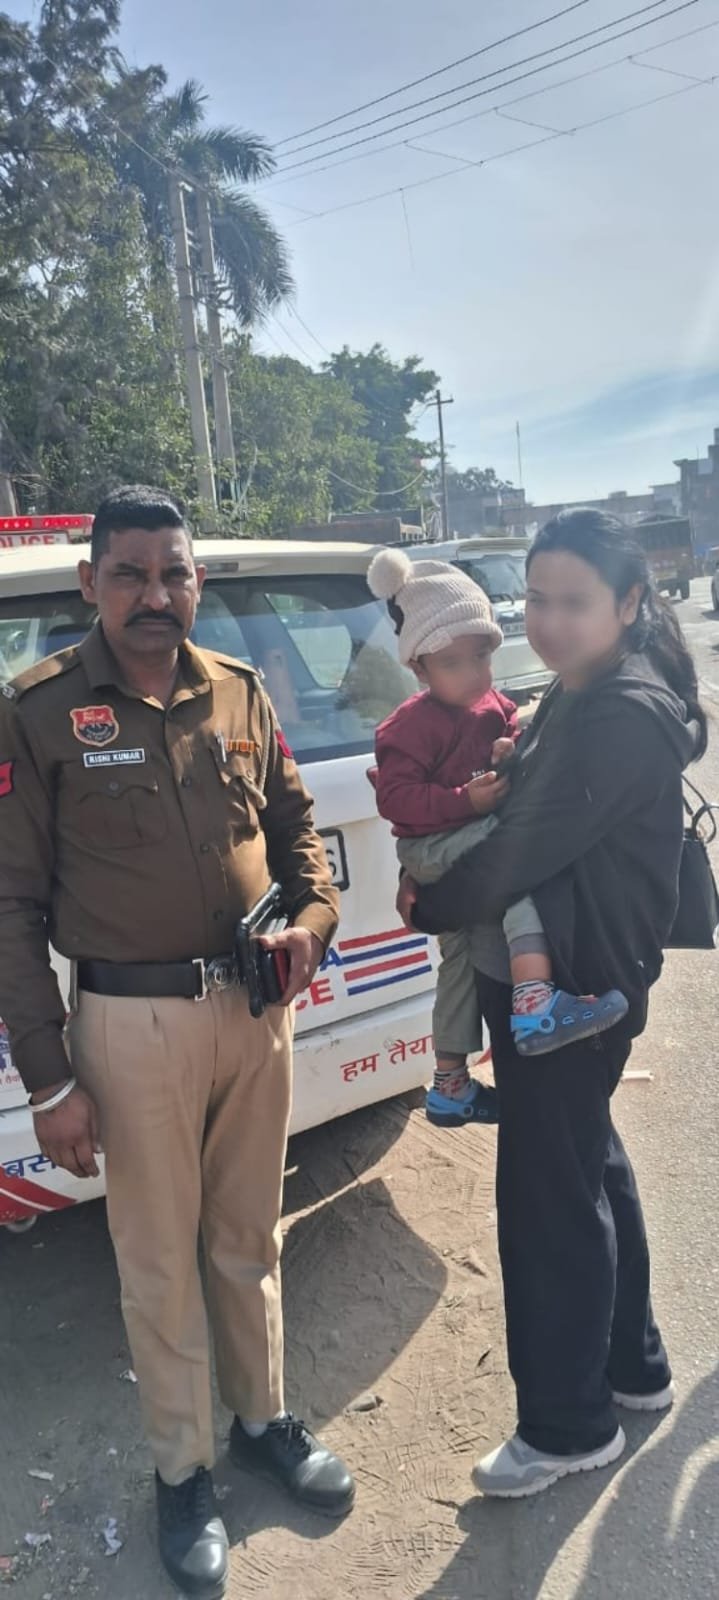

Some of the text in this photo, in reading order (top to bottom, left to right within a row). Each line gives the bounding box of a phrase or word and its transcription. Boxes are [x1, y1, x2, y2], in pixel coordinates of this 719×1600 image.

[89, 751, 141, 763] RISHI KUMAR
[340, 1053, 380, 1082] हम
